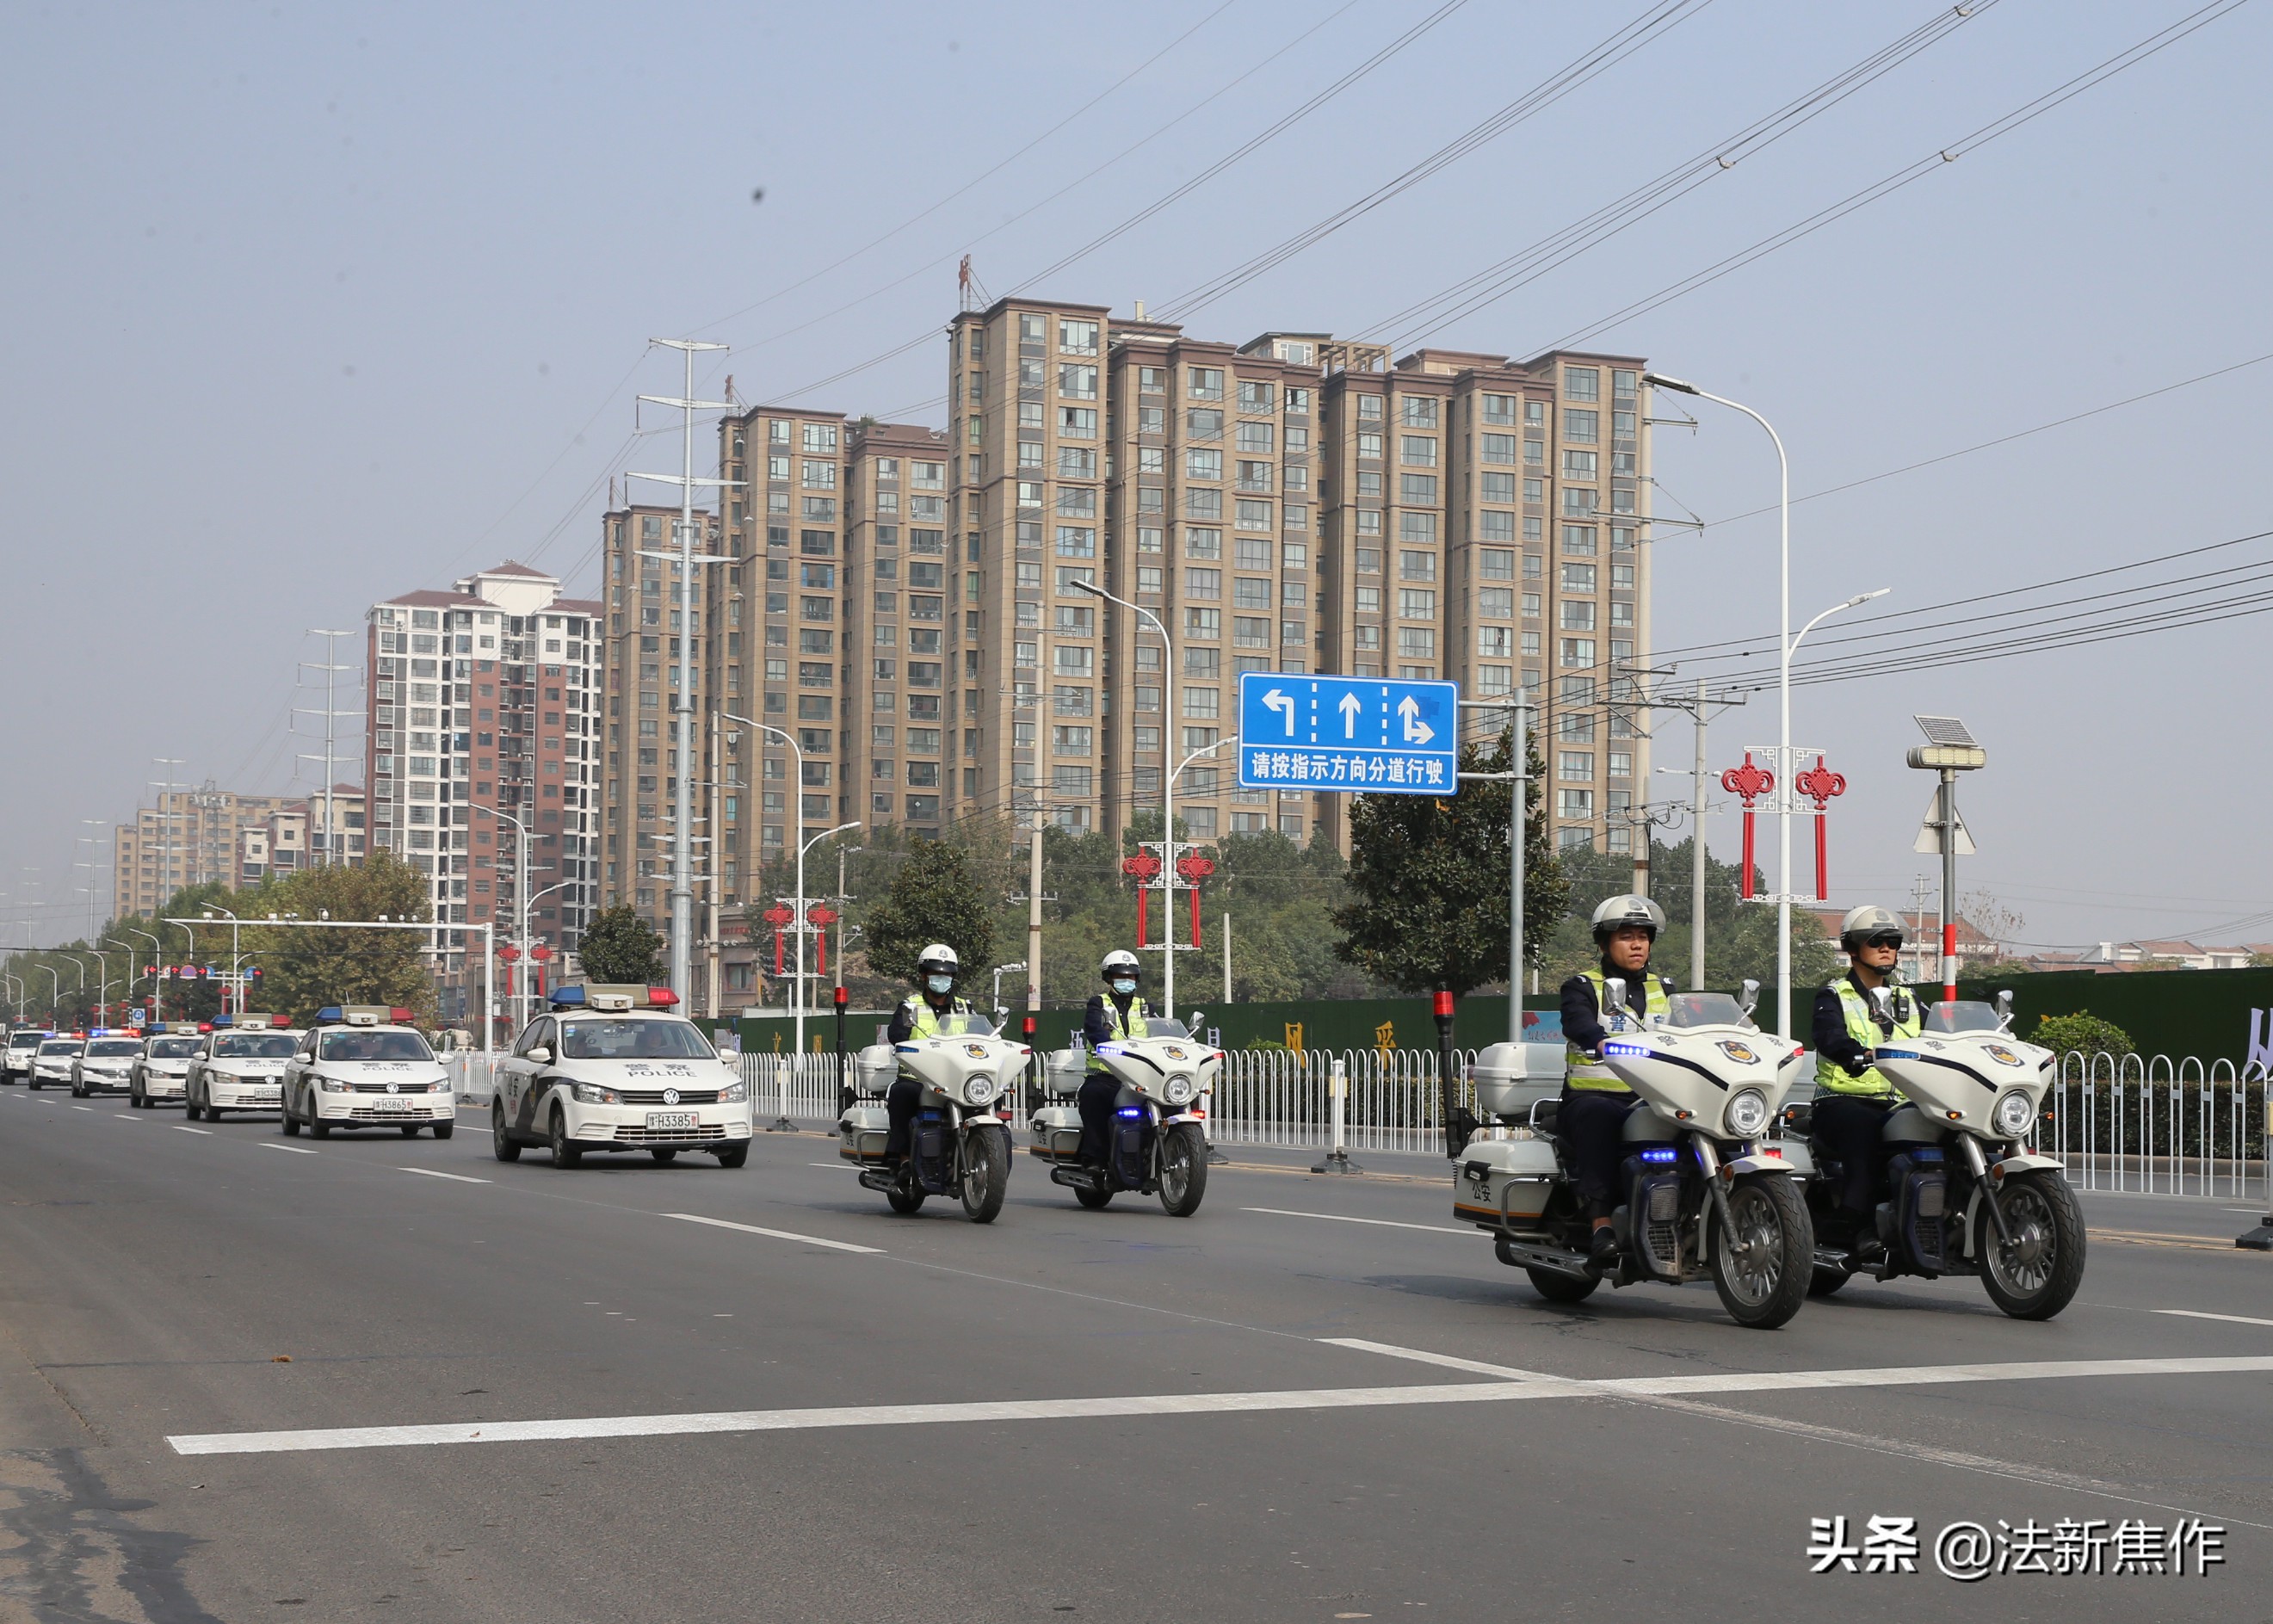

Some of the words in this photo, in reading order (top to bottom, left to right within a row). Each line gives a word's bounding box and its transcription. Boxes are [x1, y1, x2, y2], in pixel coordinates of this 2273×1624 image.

[1251, 751, 1443, 785] 请按指示方向分道行驶
[1472, 1182, 1492, 1203] 公安
